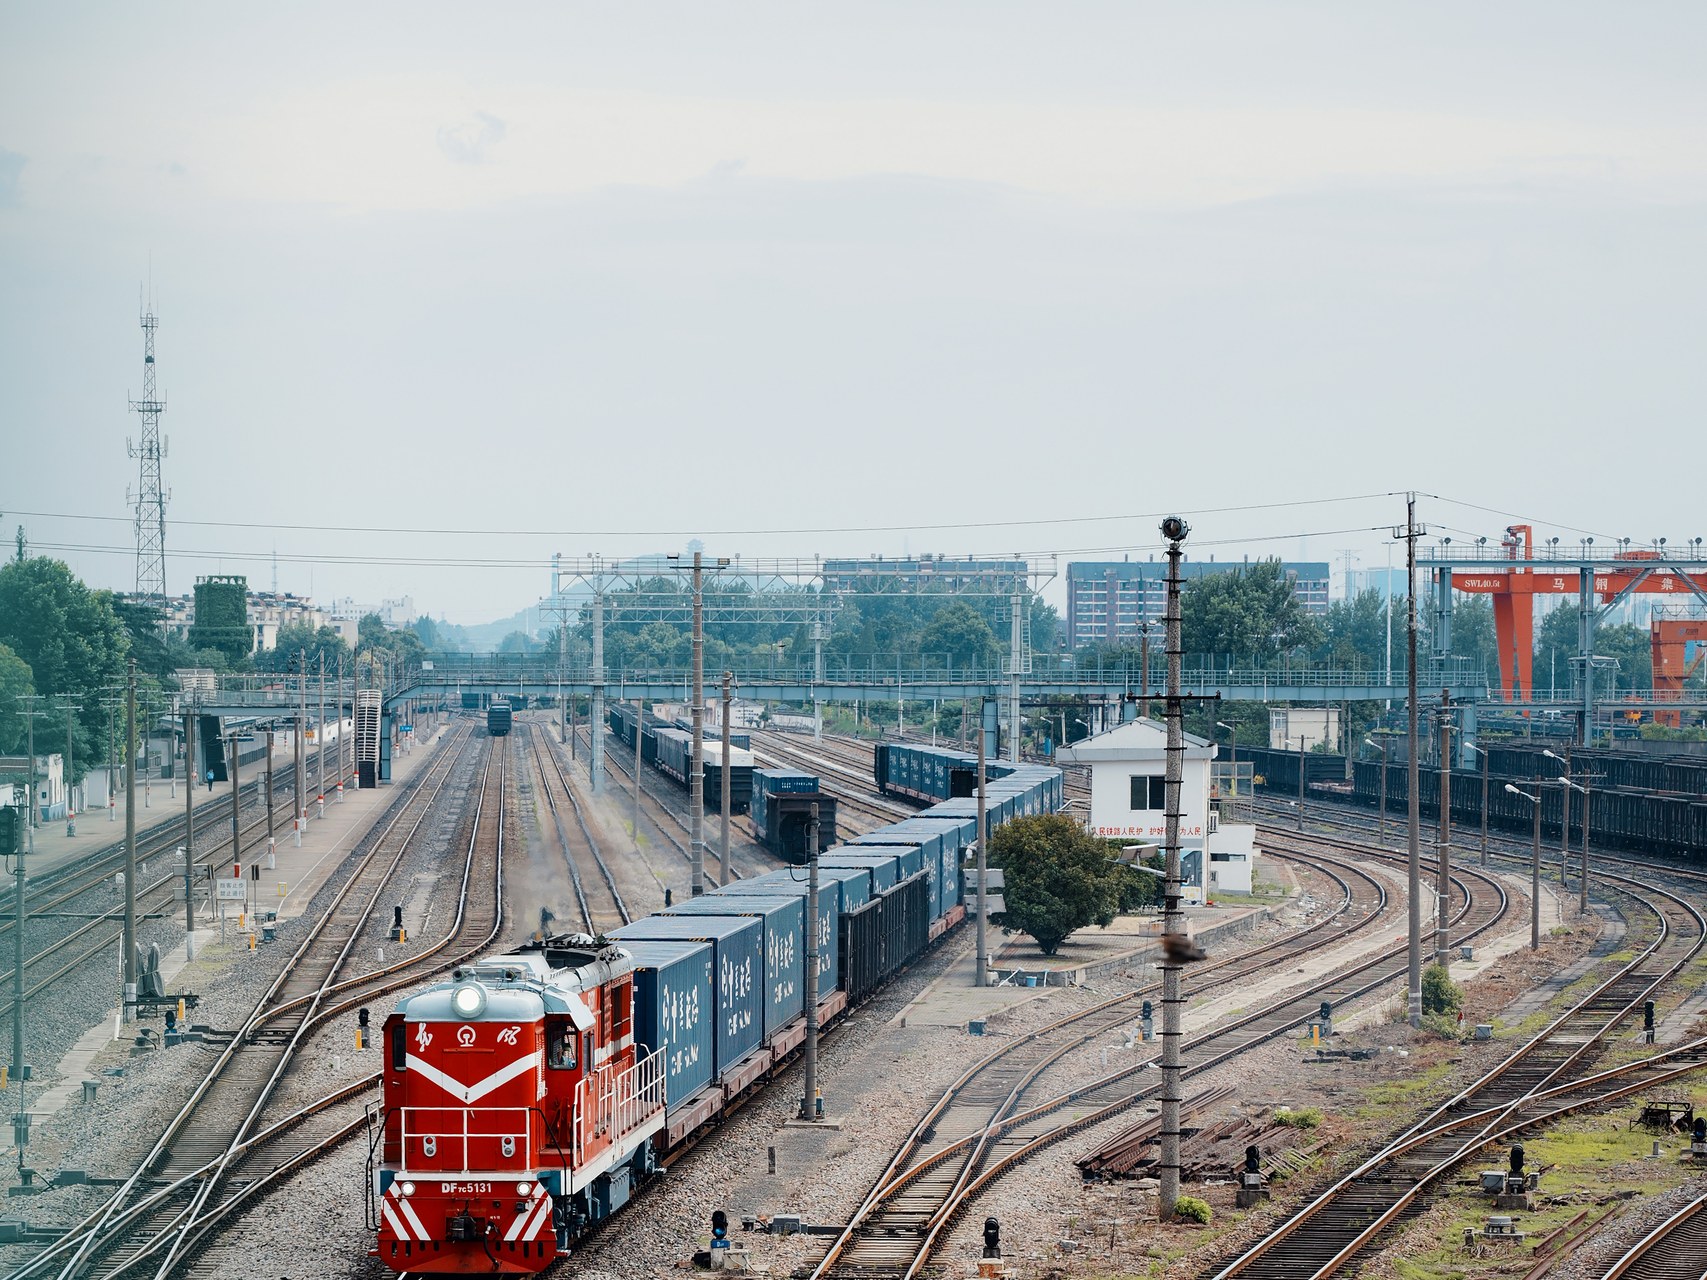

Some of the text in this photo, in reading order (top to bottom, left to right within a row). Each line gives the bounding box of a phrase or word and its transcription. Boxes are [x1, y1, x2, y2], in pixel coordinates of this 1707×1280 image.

[1149, 826, 1201, 836] 护好为人民
